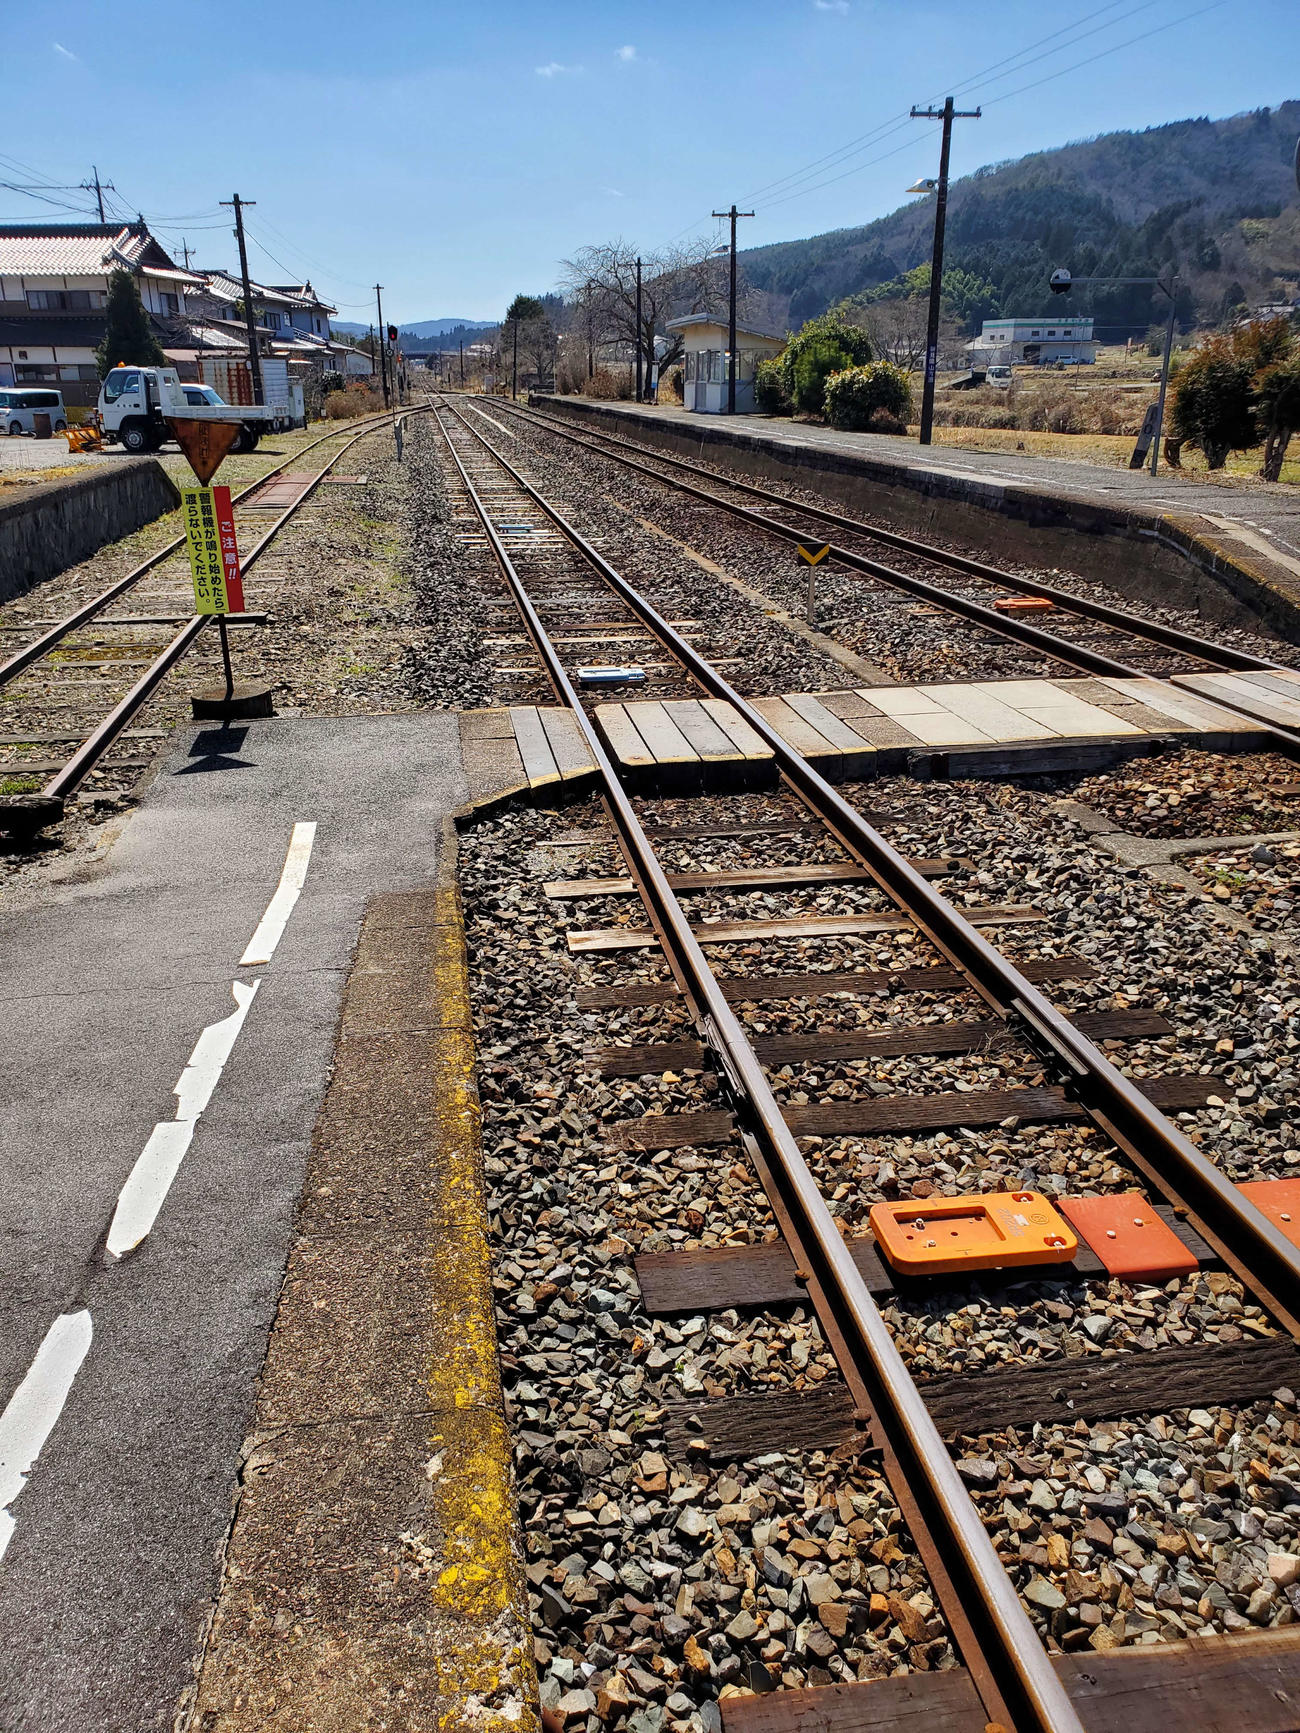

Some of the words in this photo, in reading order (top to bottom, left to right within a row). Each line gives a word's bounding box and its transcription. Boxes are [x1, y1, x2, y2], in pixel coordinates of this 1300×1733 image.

[185, 493, 211, 604] 渡らないでください。
